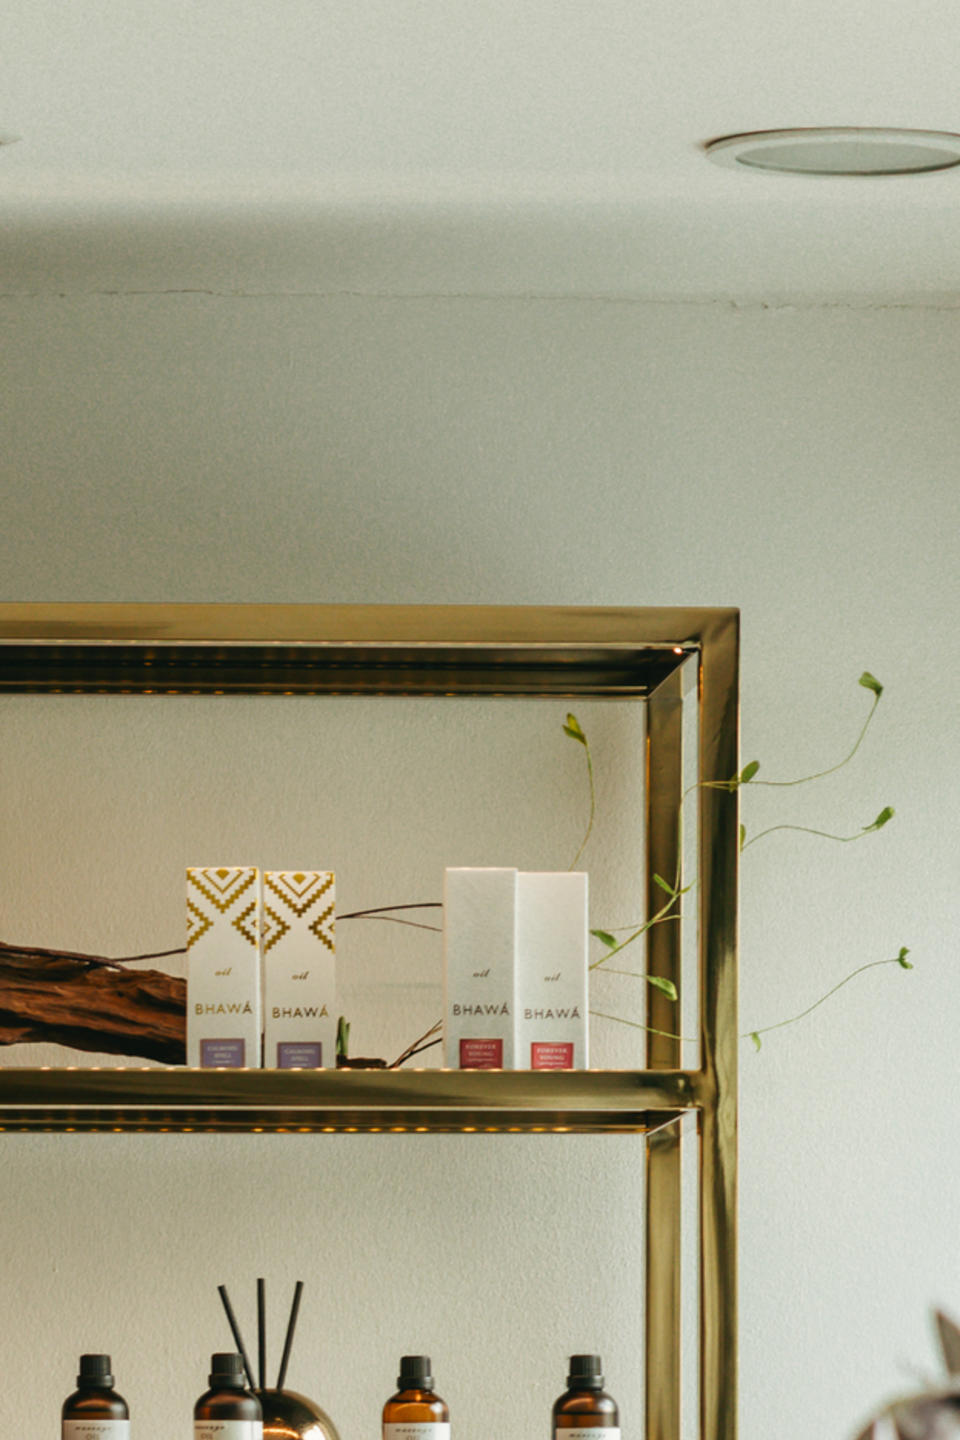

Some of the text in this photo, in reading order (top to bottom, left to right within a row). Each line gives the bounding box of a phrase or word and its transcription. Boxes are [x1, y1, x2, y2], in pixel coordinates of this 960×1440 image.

[194, 1001, 253, 1015] BHAWÁ
[271, 1004, 329, 1019] BHAWÁ
[452, 1002, 511, 1016] BHAWÁ
[523, 1006, 581, 1020] BHAWÁ
